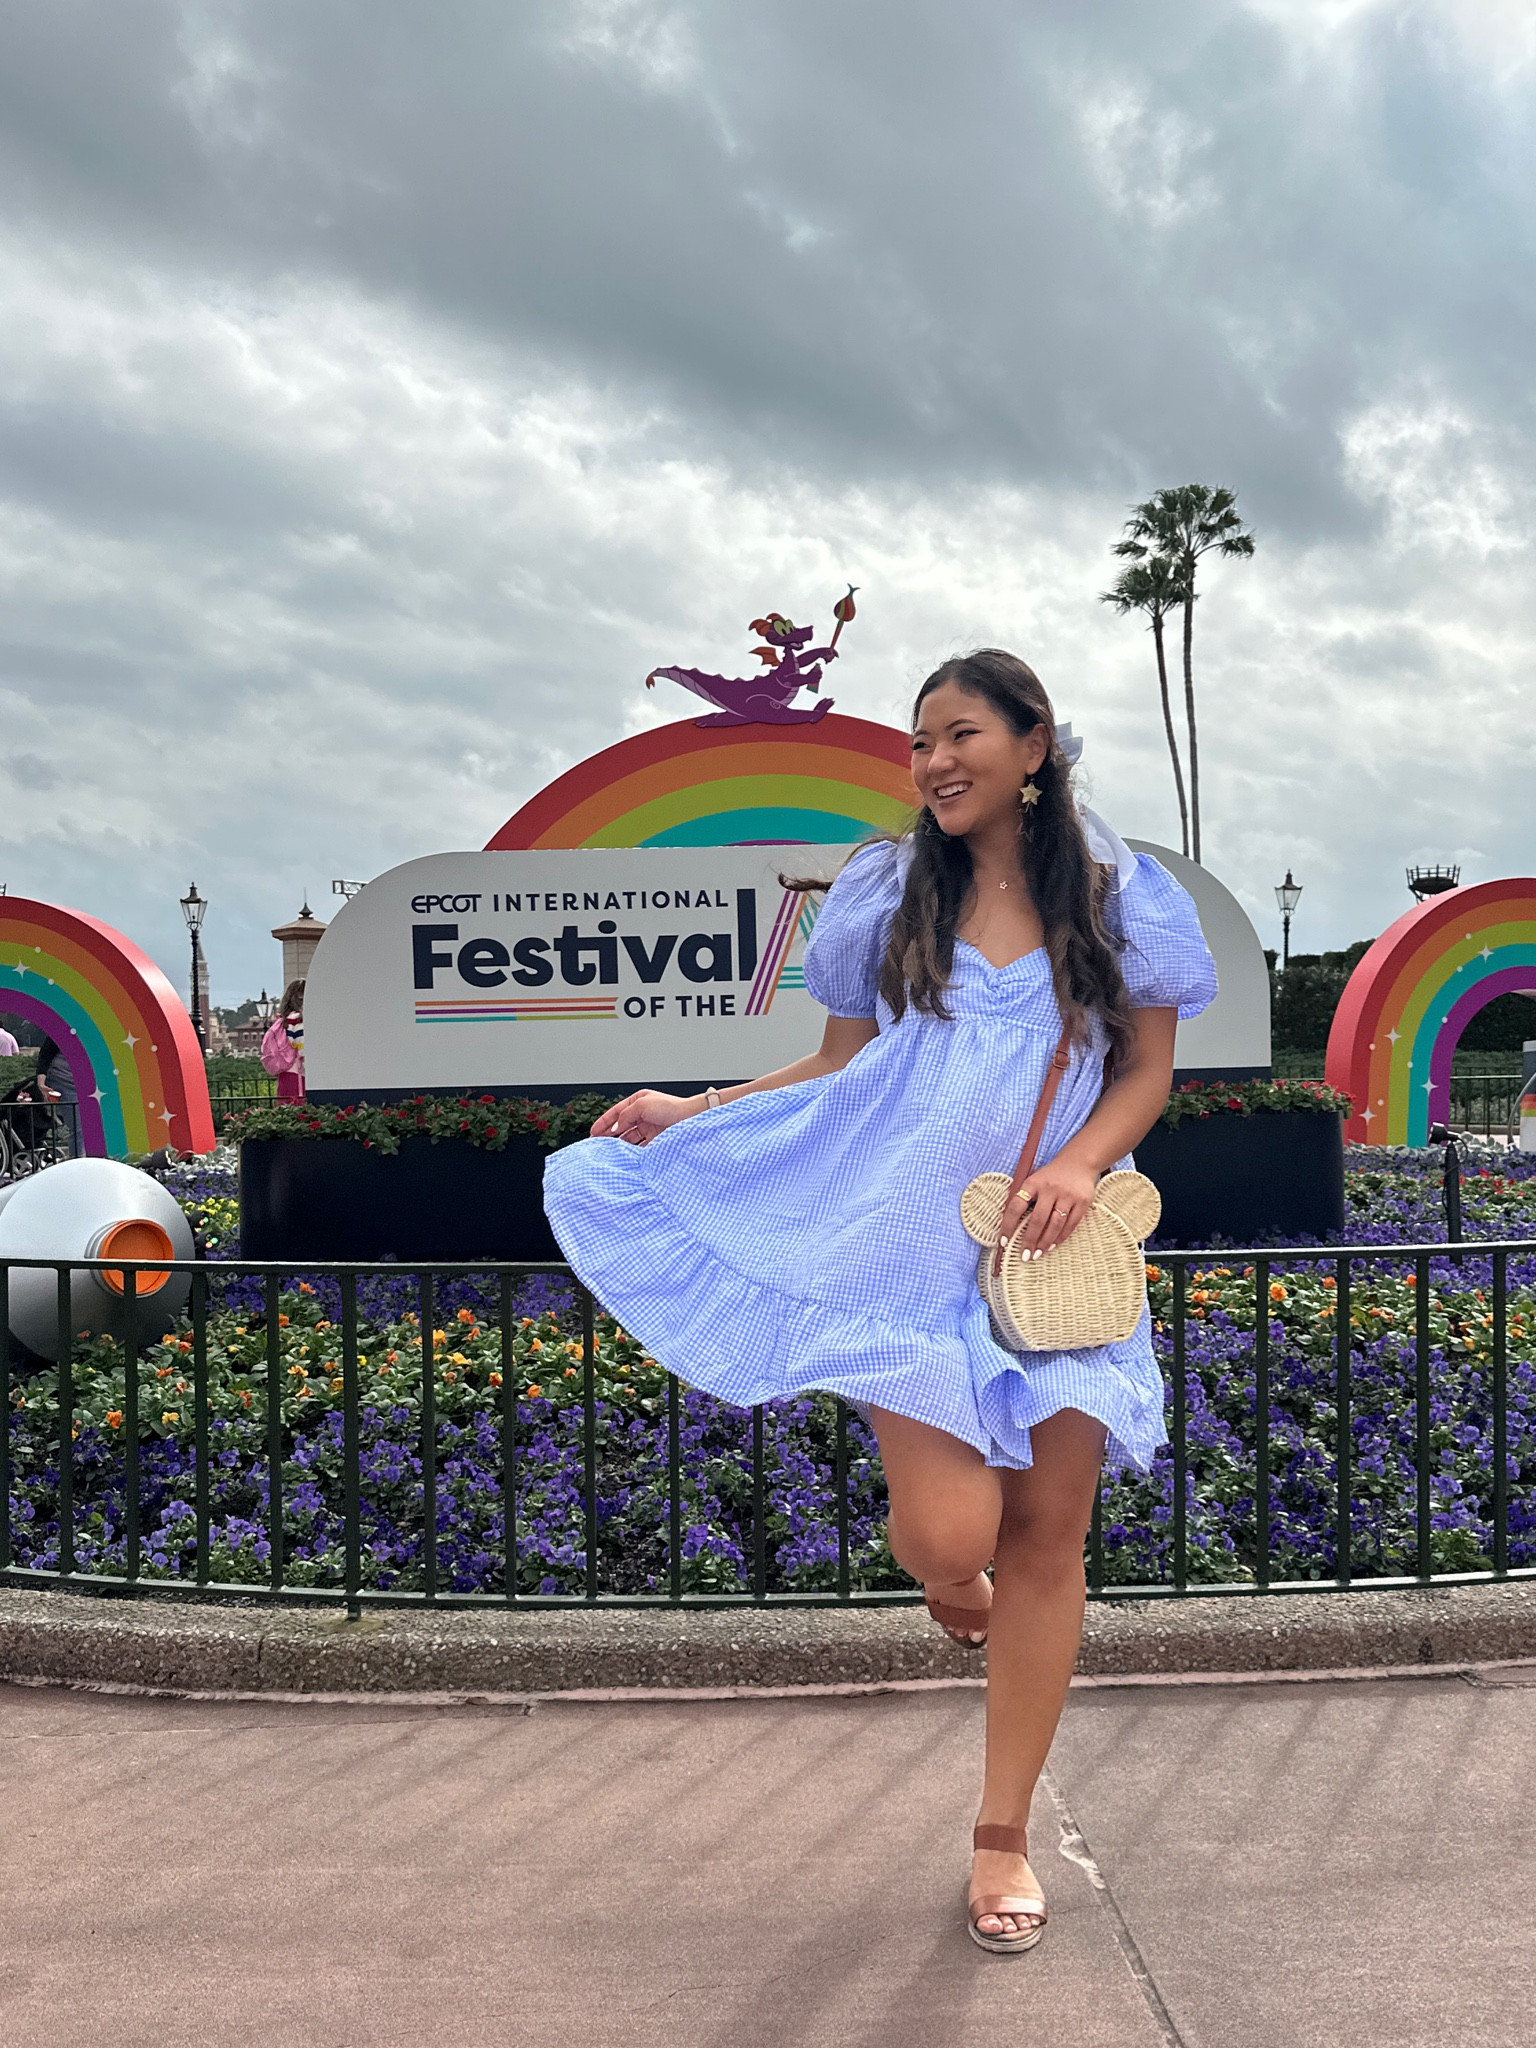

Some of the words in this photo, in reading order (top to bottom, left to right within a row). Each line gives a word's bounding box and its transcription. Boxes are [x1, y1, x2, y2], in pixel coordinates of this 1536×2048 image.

[411, 893, 482, 914] EPCOT
[493, 889, 729, 912] INTERNATIONAL
[411, 888, 758, 990] Festival
[623, 996, 665, 1019] OF
[675, 994, 736, 1017] THE
